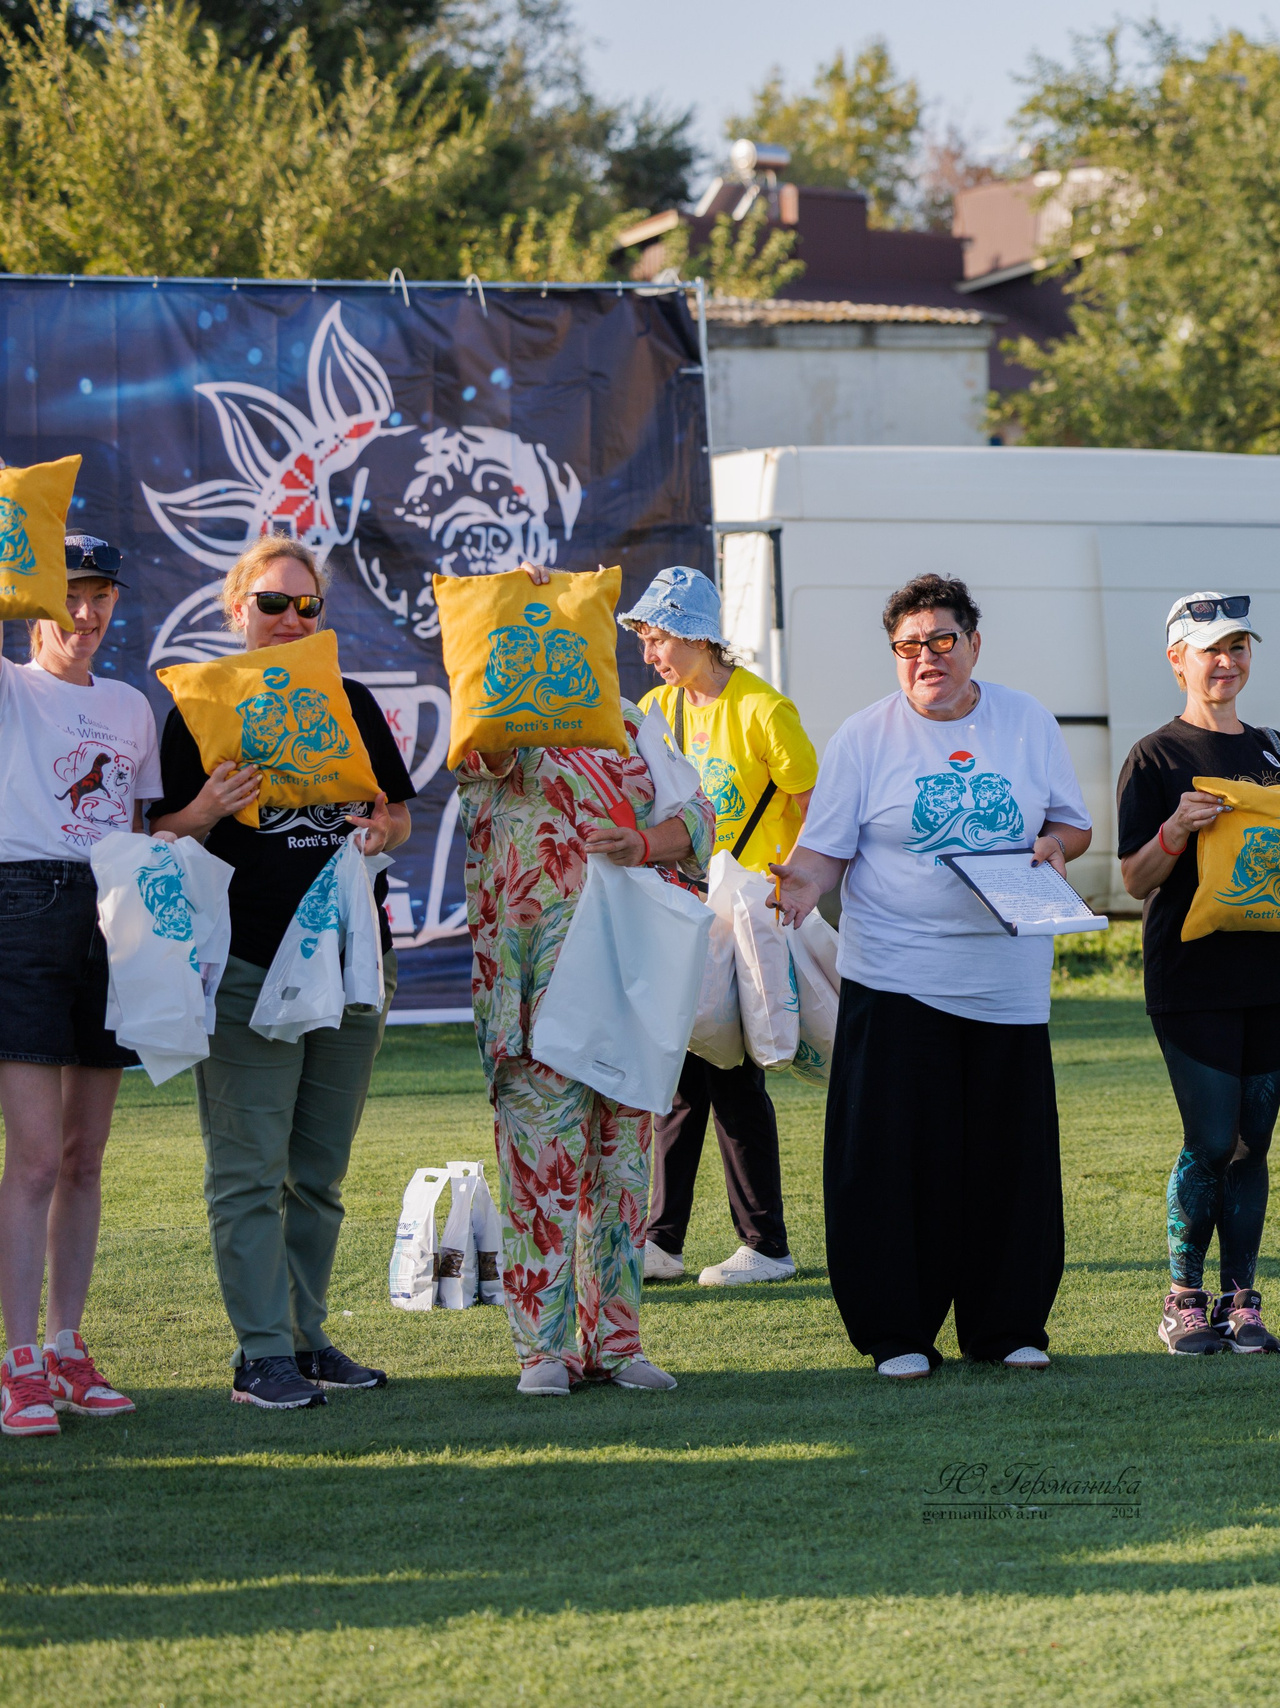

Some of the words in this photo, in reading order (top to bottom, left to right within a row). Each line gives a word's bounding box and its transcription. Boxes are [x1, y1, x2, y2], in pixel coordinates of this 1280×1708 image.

[505, 719, 549, 732] Rotti's
[553, 718, 583, 730] Rest
[77, 727, 118, 742] Winner
[270, 774, 310, 787] Rotti's
[313, 771, 340, 785] Rest
[287, 834, 329, 849] Rotti's
[329, 833, 348, 846] Re
